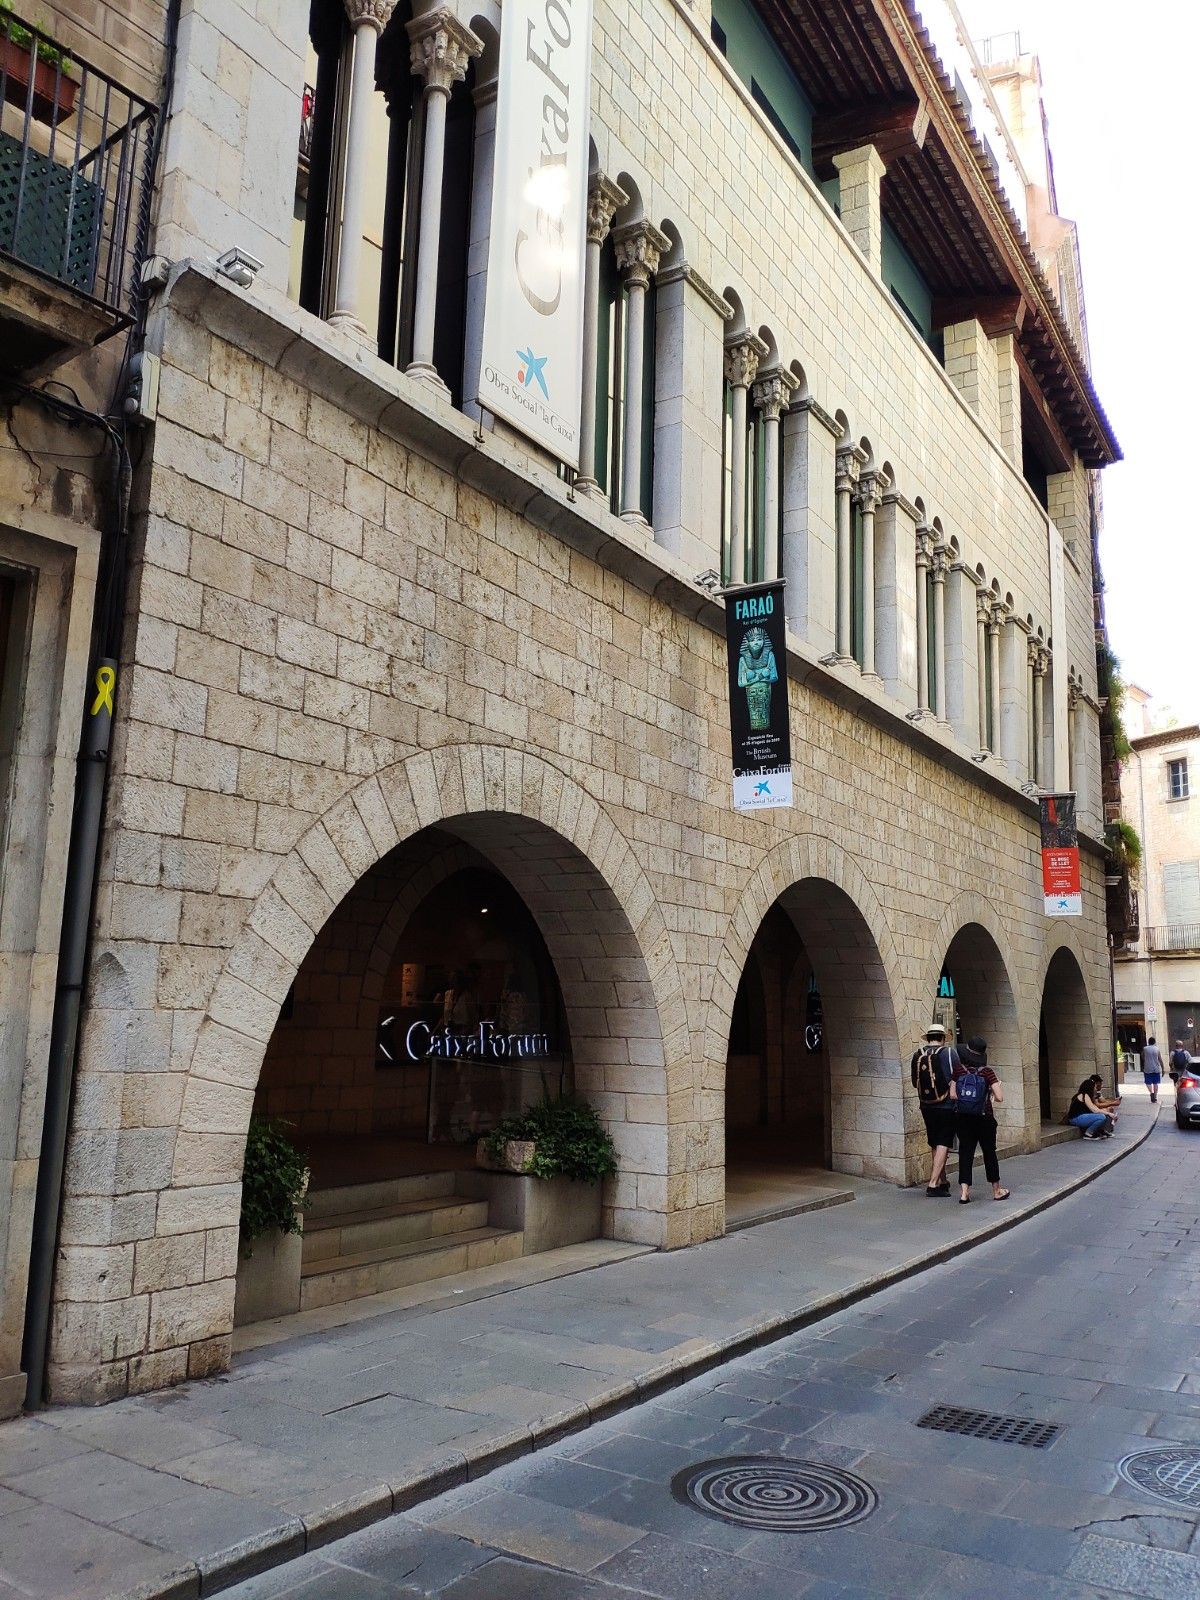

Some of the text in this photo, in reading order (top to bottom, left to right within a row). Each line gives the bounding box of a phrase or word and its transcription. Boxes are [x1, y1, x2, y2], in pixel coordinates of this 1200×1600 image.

[485, 367, 509, 394] Obra
[512, 385, 538, 415] Social
[735, 592, 774, 620] FARAÓ
[753, 747, 771, 755] British
[733, 765, 791, 778] CaixaForum
[406, 1020, 550, 1060] CaixaForum
